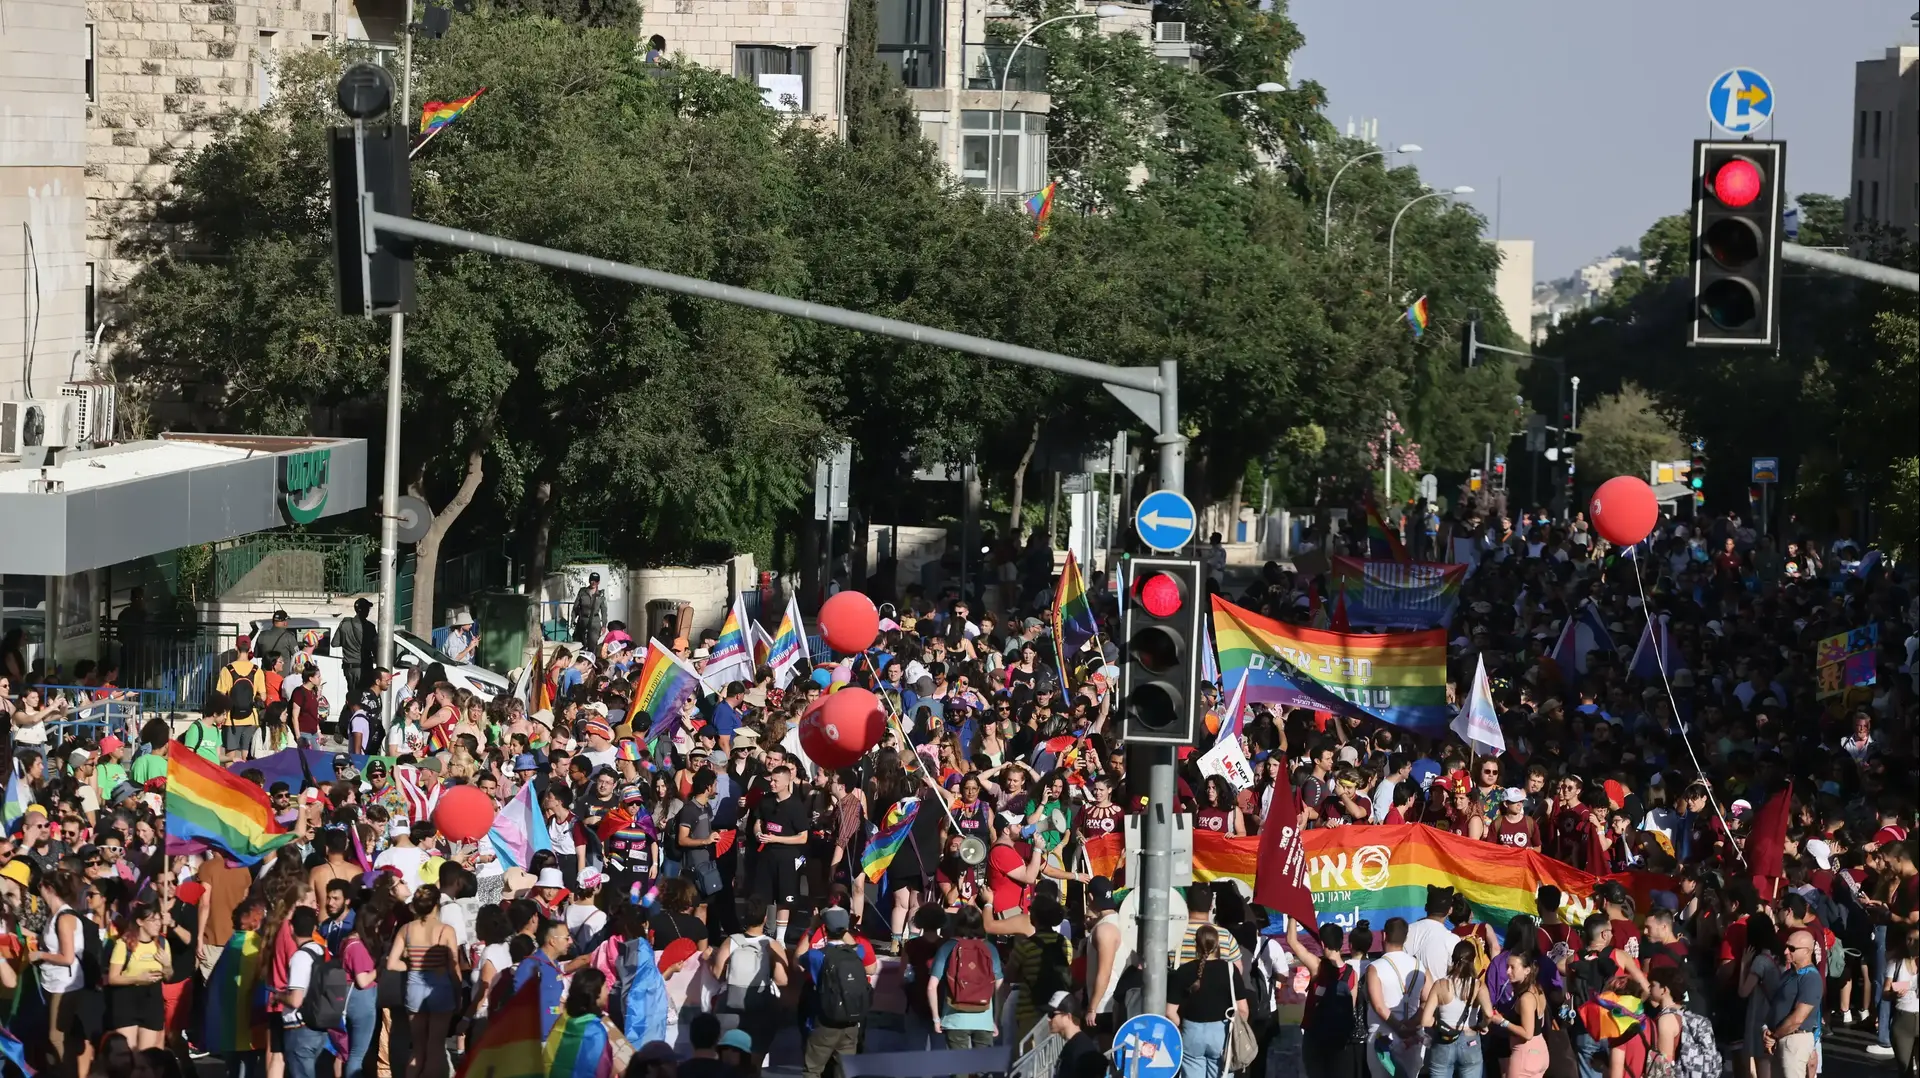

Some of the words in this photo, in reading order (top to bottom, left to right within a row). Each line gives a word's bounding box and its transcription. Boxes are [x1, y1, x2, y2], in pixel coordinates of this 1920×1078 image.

[1221, 755, 1239, 781] LOVE
[1234, 761, 1251, 784] EVERY
[1328, 890, 1351, 904] ארגון
